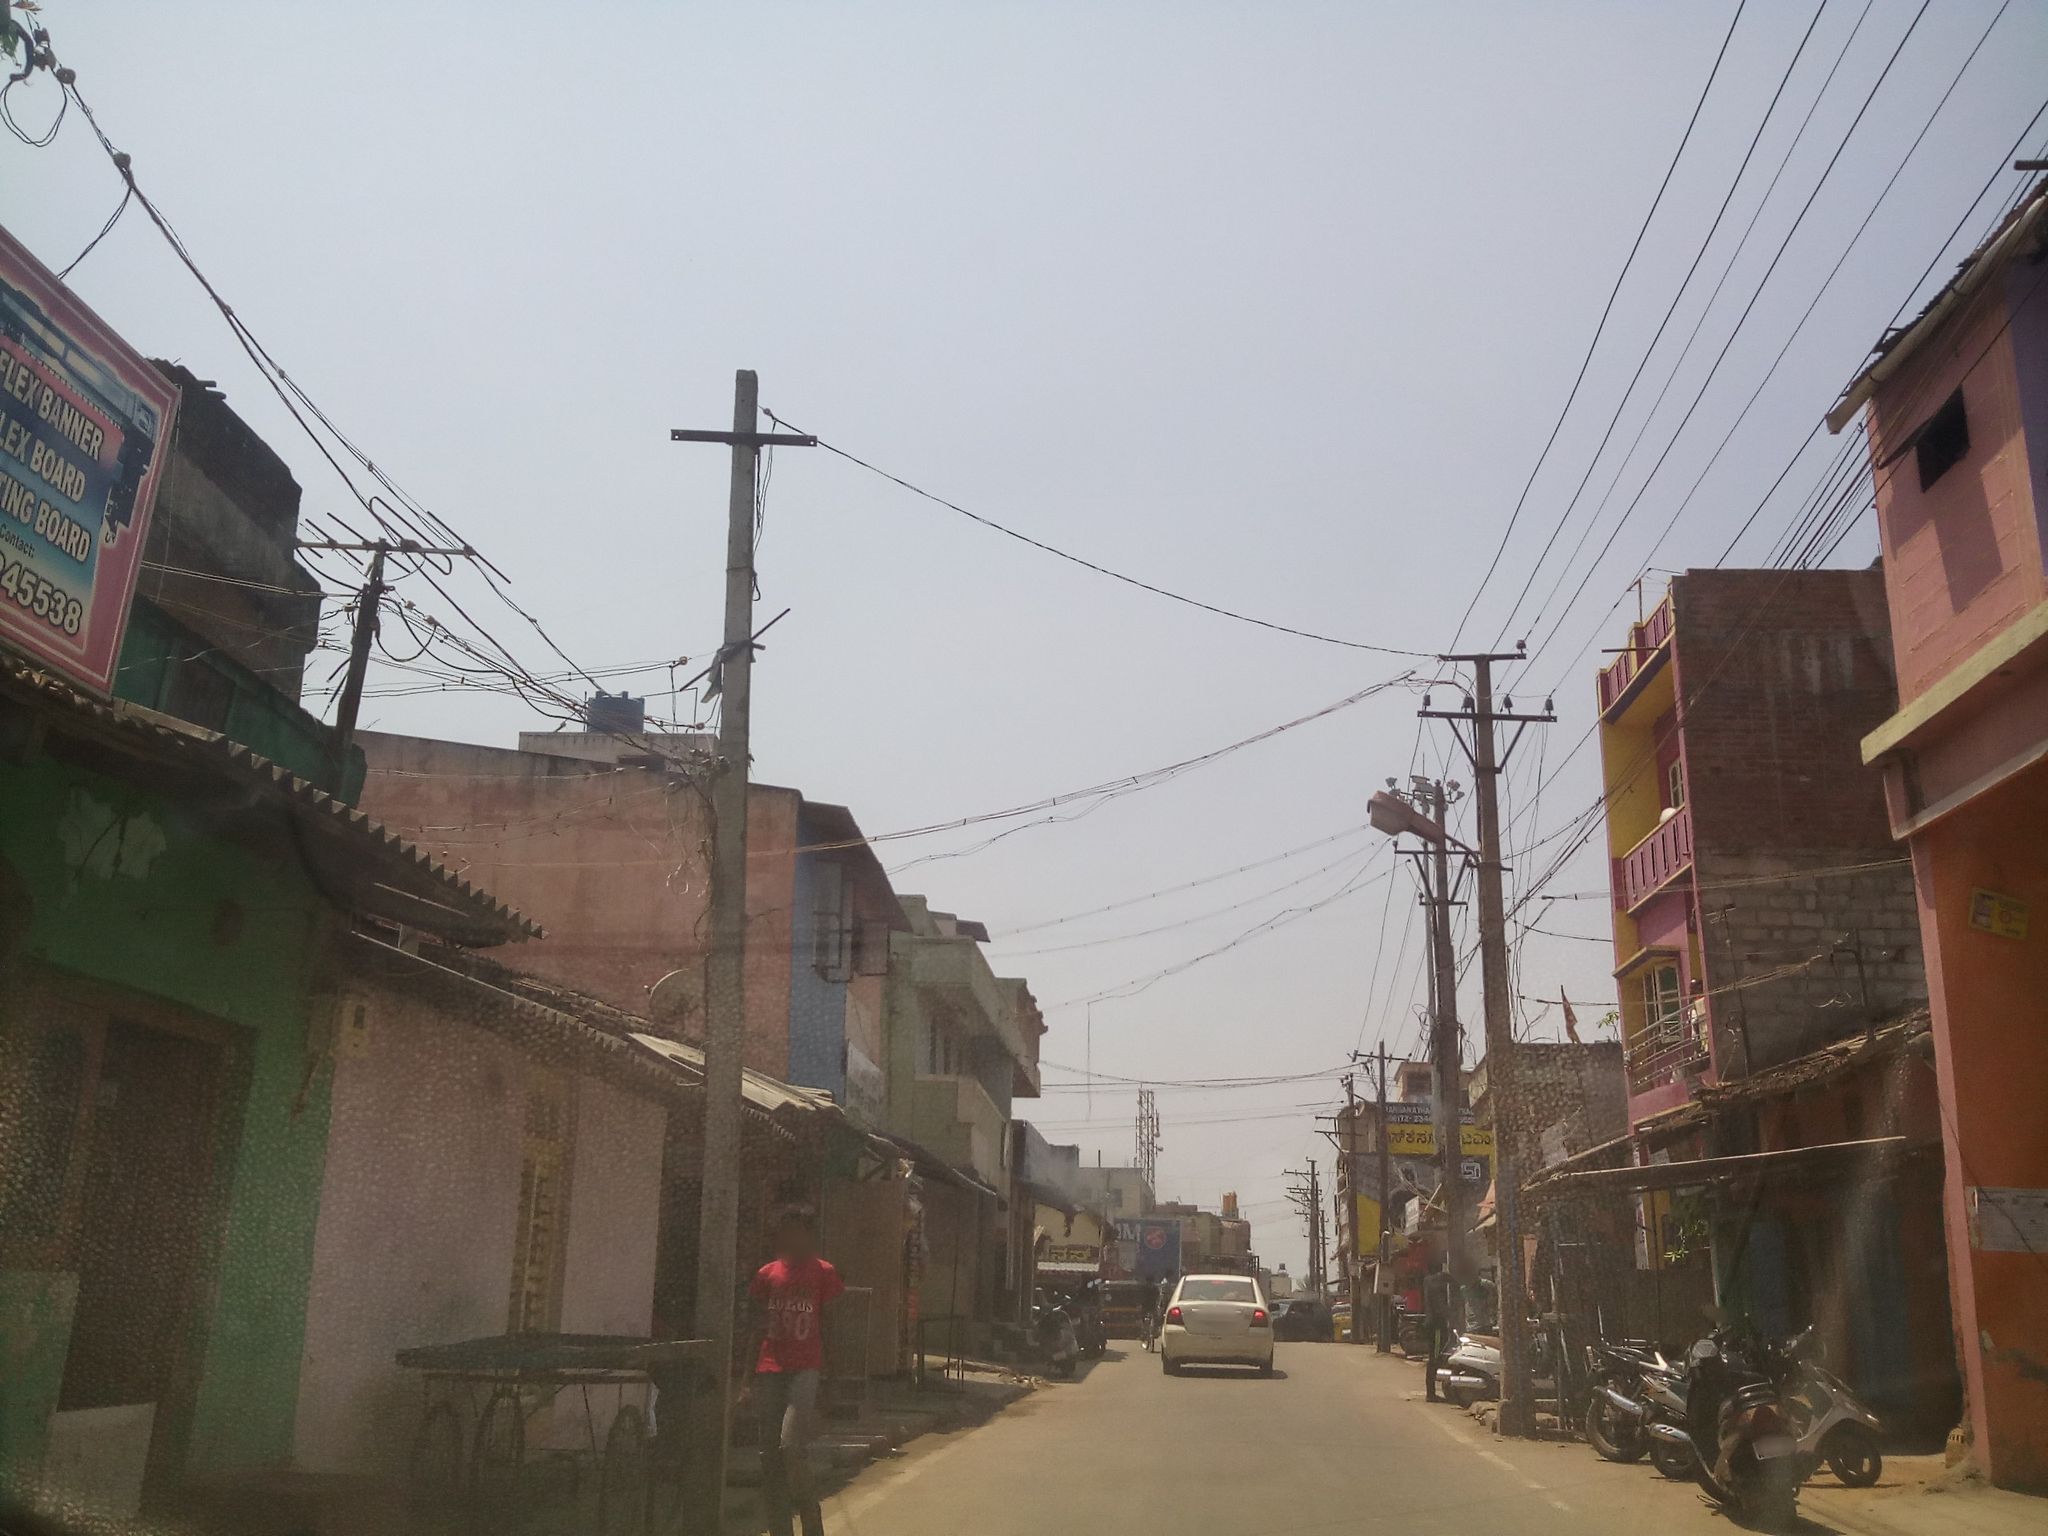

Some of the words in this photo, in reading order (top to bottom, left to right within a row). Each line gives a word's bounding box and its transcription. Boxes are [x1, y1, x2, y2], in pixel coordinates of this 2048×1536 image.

[38, 386, 103, 461] BANNER
[30, 438, 86, 502] BOARD
[34, 500, 91, 562] BOARD
